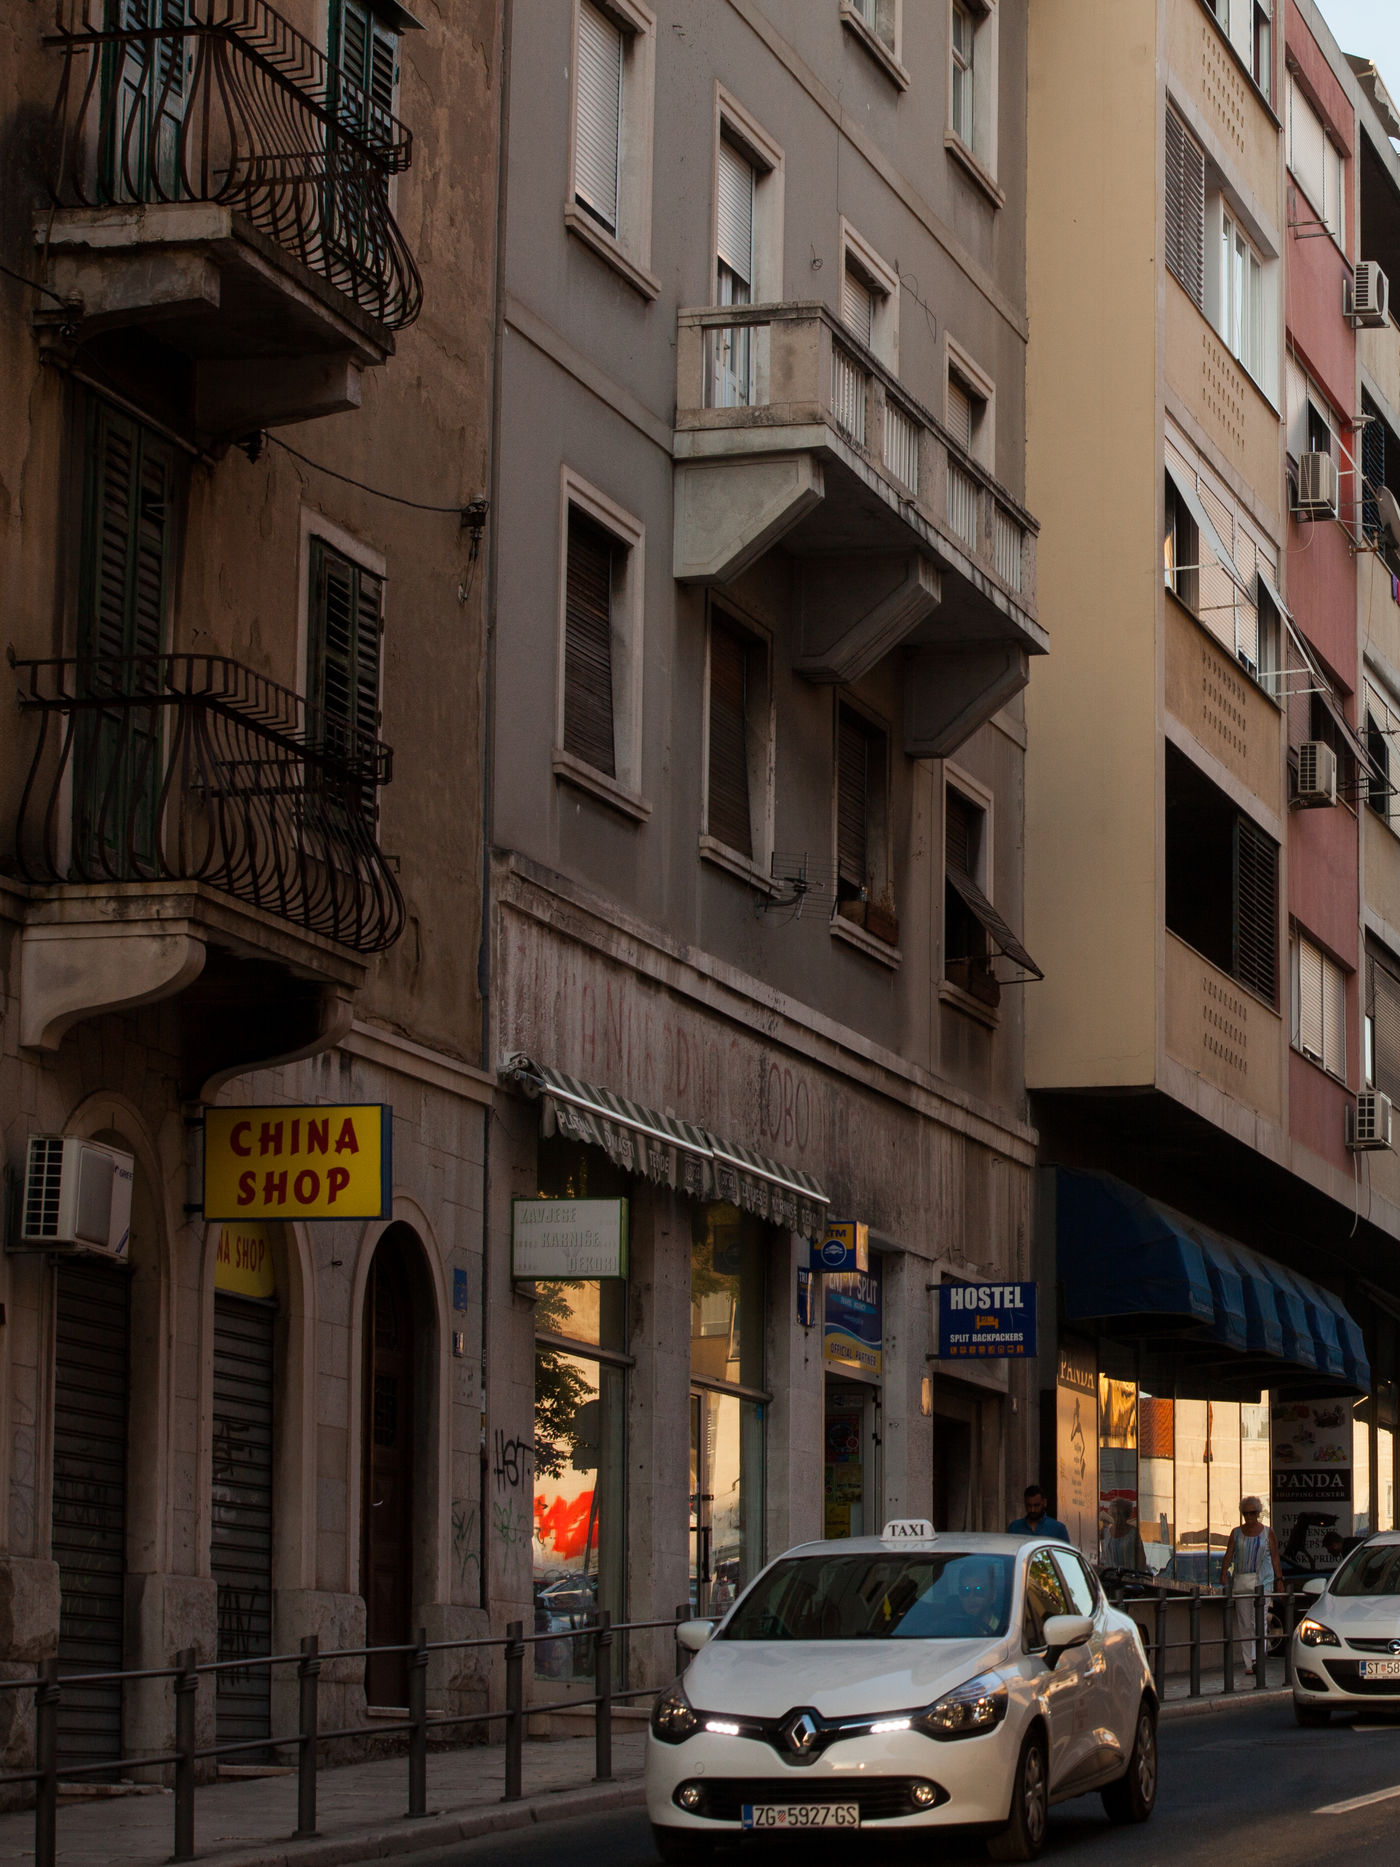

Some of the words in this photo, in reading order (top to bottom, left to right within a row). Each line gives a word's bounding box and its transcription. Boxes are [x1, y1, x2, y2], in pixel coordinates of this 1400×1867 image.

[230, 1117, 359, 1157] CHINA
[237, 1167, 350, 1206] SHOP
[236, 1235, 265, 1273] SHOP
[857, 1274, 878, 1304] SPLIT
[949, 1286, 1024, 1310] HOSTEL
[949, 1334, 969, 1343] SPLIT
[972, 1333, 1024, 1343] BACKPACKERS
[830, 1342, 852, 1359] OFFICIAL
[855, 1350, 877, 1366] PARTNER
[1060, 1350, 1095, 1389] PANDA
[1275, 1473, 1344, 1488] PANDA
[888, 1524, 925, 1536] TAXI
[1367, 1662, 1379, 1674] ST
[754, 1807, 776, 1826] ZG
